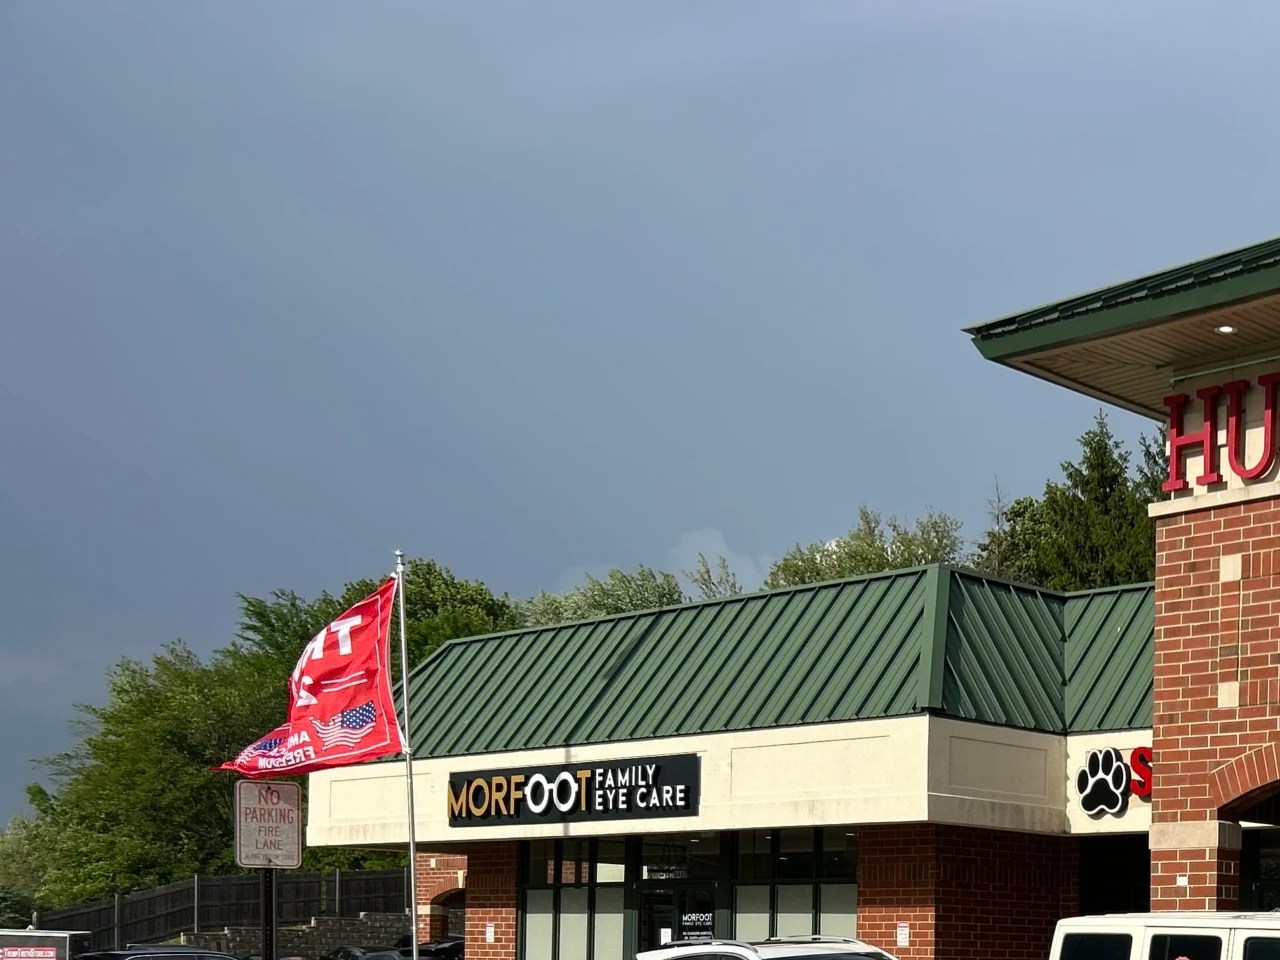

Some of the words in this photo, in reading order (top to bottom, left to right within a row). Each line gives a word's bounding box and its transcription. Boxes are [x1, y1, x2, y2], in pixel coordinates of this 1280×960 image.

[258, 789, 281, 805] NO
[448, 769, 591, 818] MORFOOT
[595, 764, 656, 788] FAMILY
[595, 788, 628, 811] EYE
[636, 784, 686, 807] CARE
[245, 807, 294, 824] PARKING
[258, 826, 281, 836] FIRE
[255, 839, 284, 850] LANE
